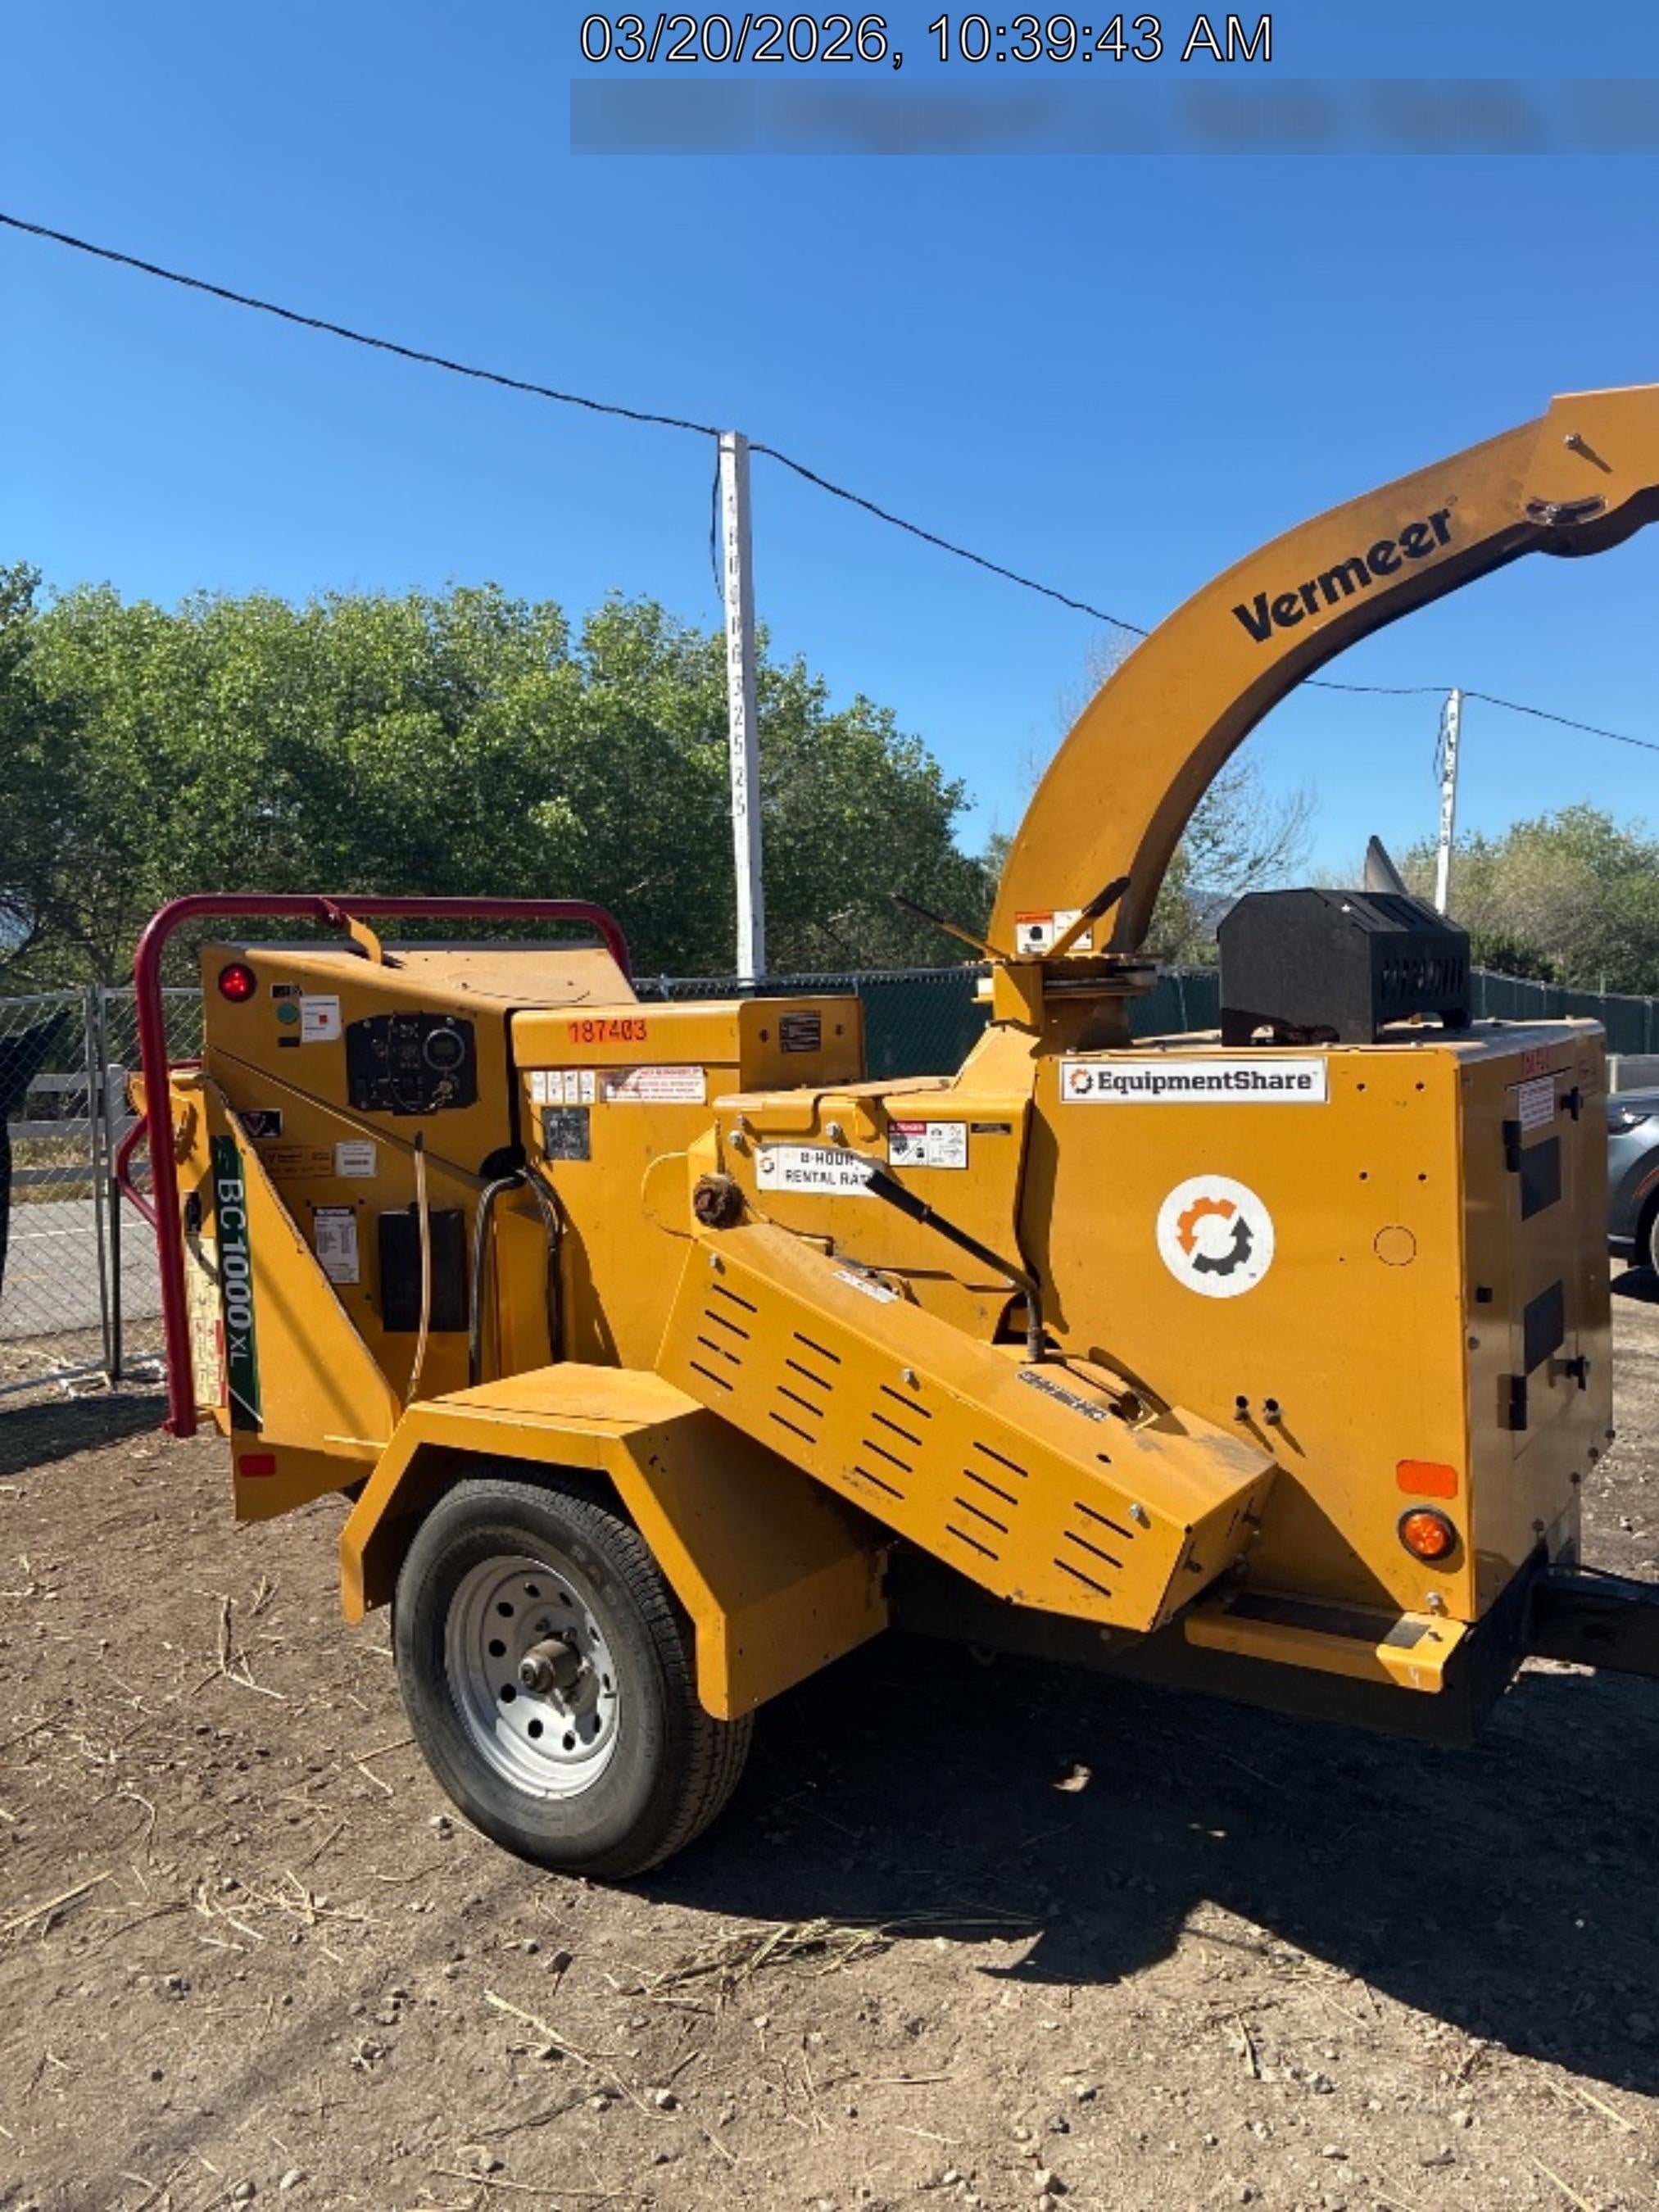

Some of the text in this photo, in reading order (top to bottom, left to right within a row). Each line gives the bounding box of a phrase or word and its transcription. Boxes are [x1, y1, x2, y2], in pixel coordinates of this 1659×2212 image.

[1231, 508, 1452, 642] Vermeer
[568, 1019, 647, 1043] 187403
[1098, 1071, 1312, 1095] EquipmentShare
[786, 1170, 868, 1185] RENTAL RAT
